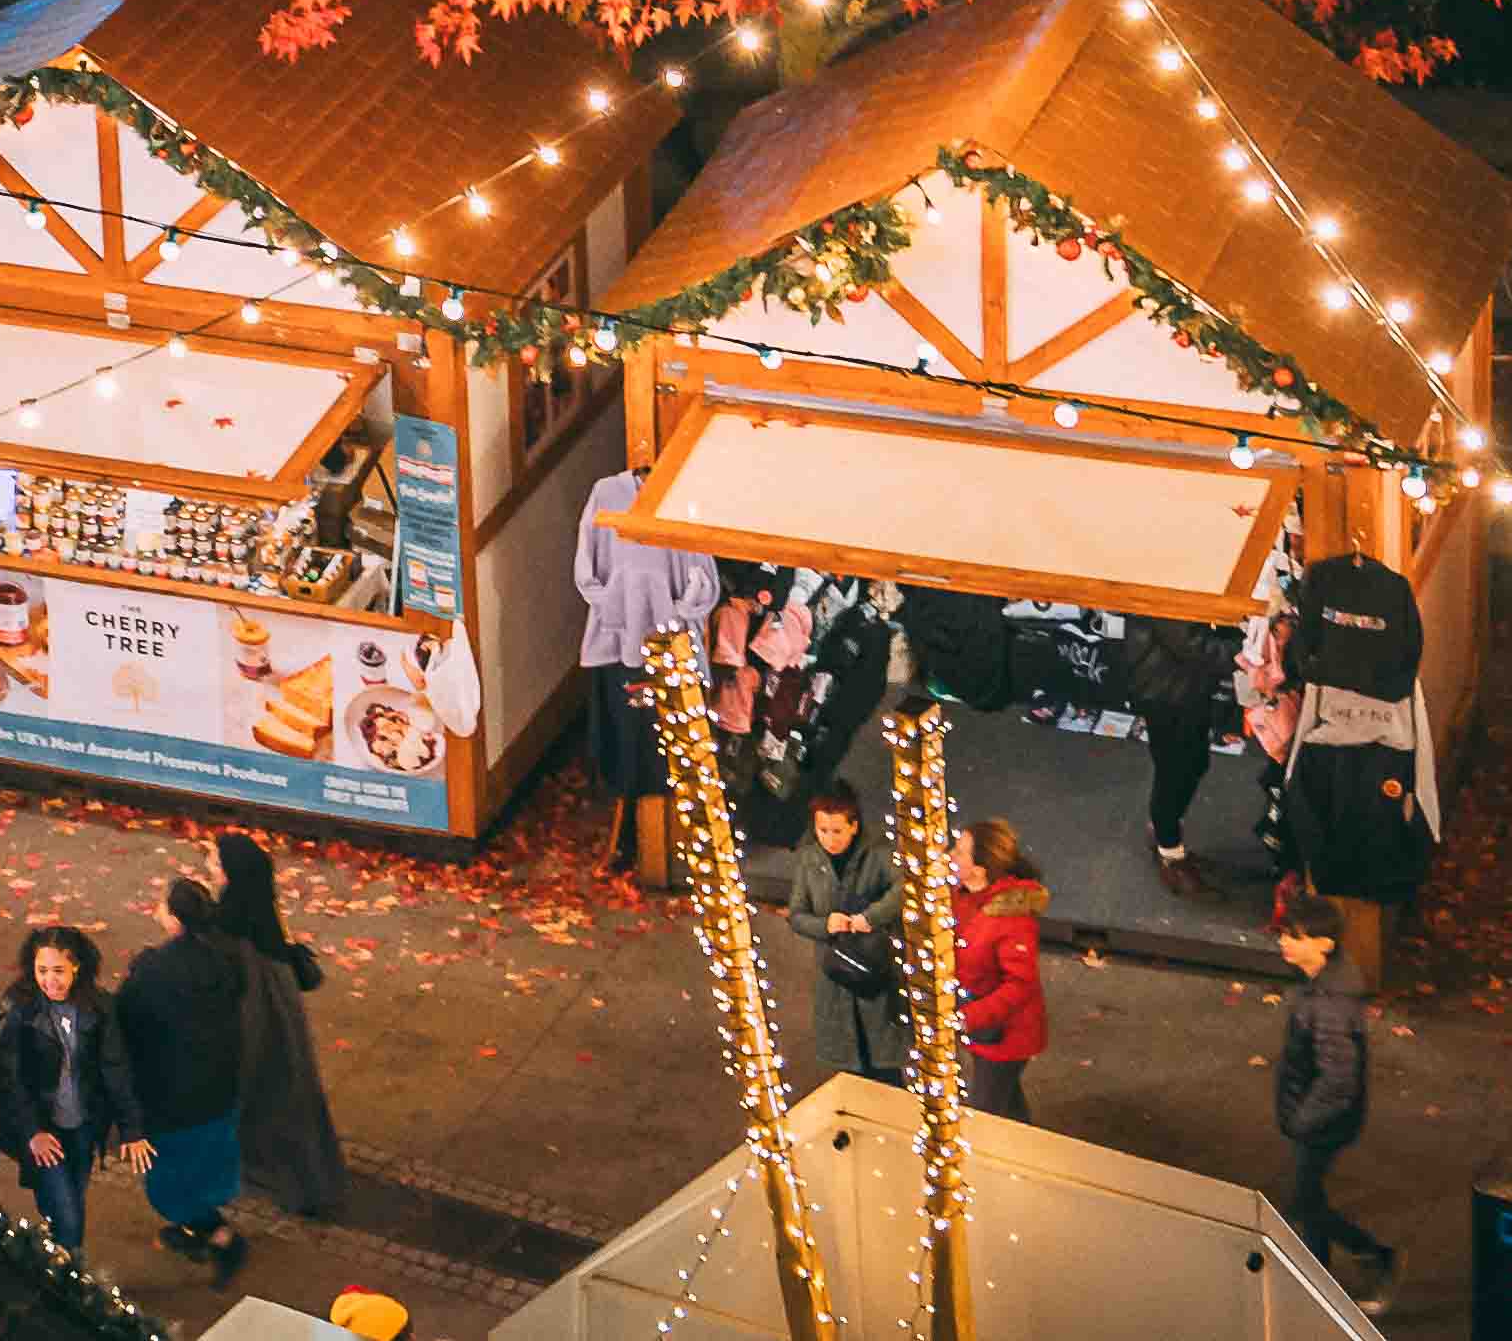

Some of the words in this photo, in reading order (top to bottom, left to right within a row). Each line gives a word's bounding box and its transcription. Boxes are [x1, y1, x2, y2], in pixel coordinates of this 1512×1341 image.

[85, 610, 180, 639] CHERRY
[103, 633, 166, 658] TREE
[49, 735, 85, 754] Most
[86, 742, 150, 764] Awarded
